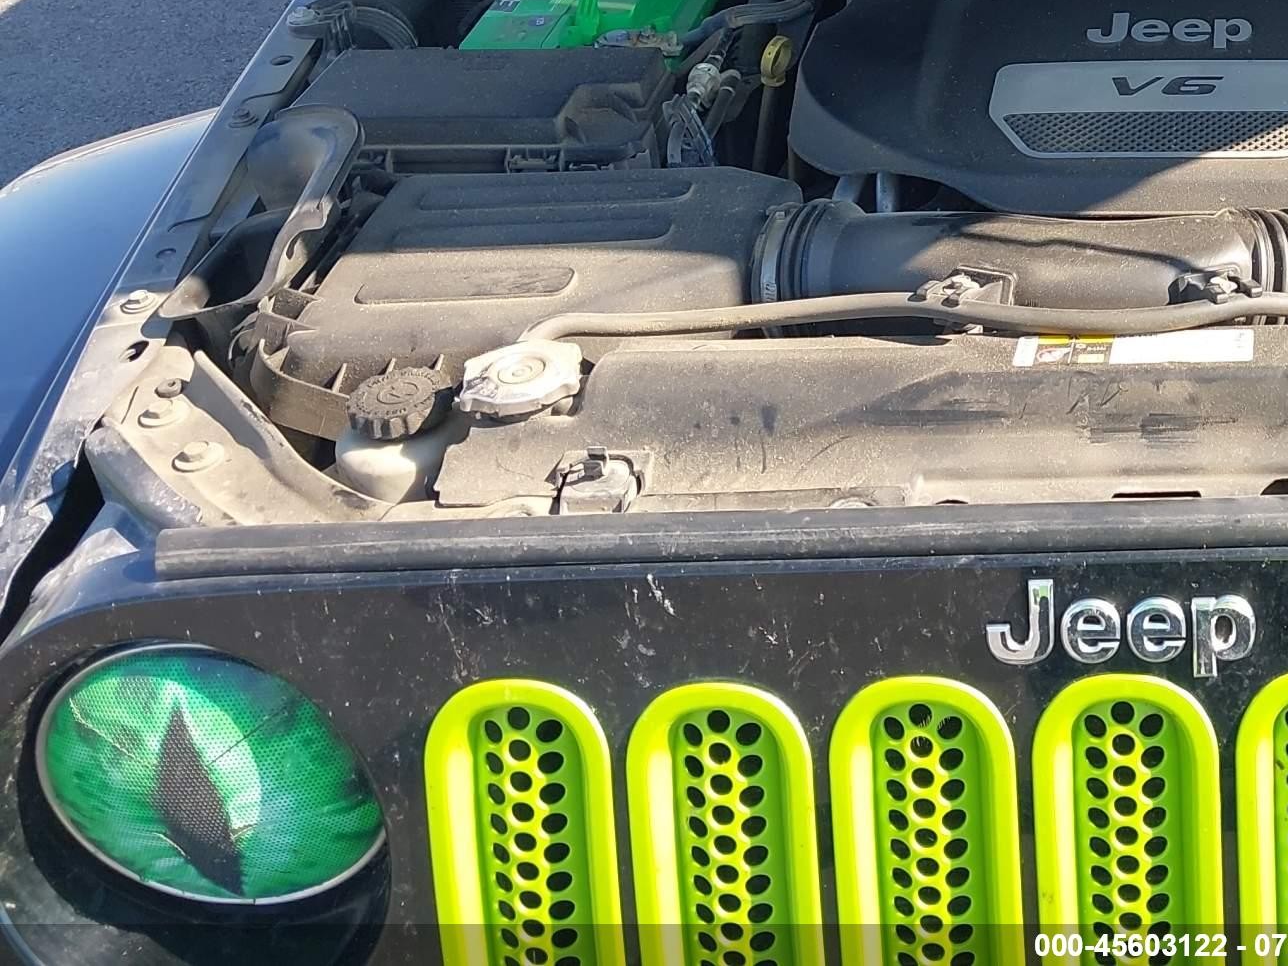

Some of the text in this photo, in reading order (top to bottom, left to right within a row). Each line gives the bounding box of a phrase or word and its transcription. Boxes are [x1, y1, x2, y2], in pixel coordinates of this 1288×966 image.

[1086, 12, 1253, 50] Jeep
[1111, 75, 1225, 97] V6
[985, 578, 1256, 678] Jeep
